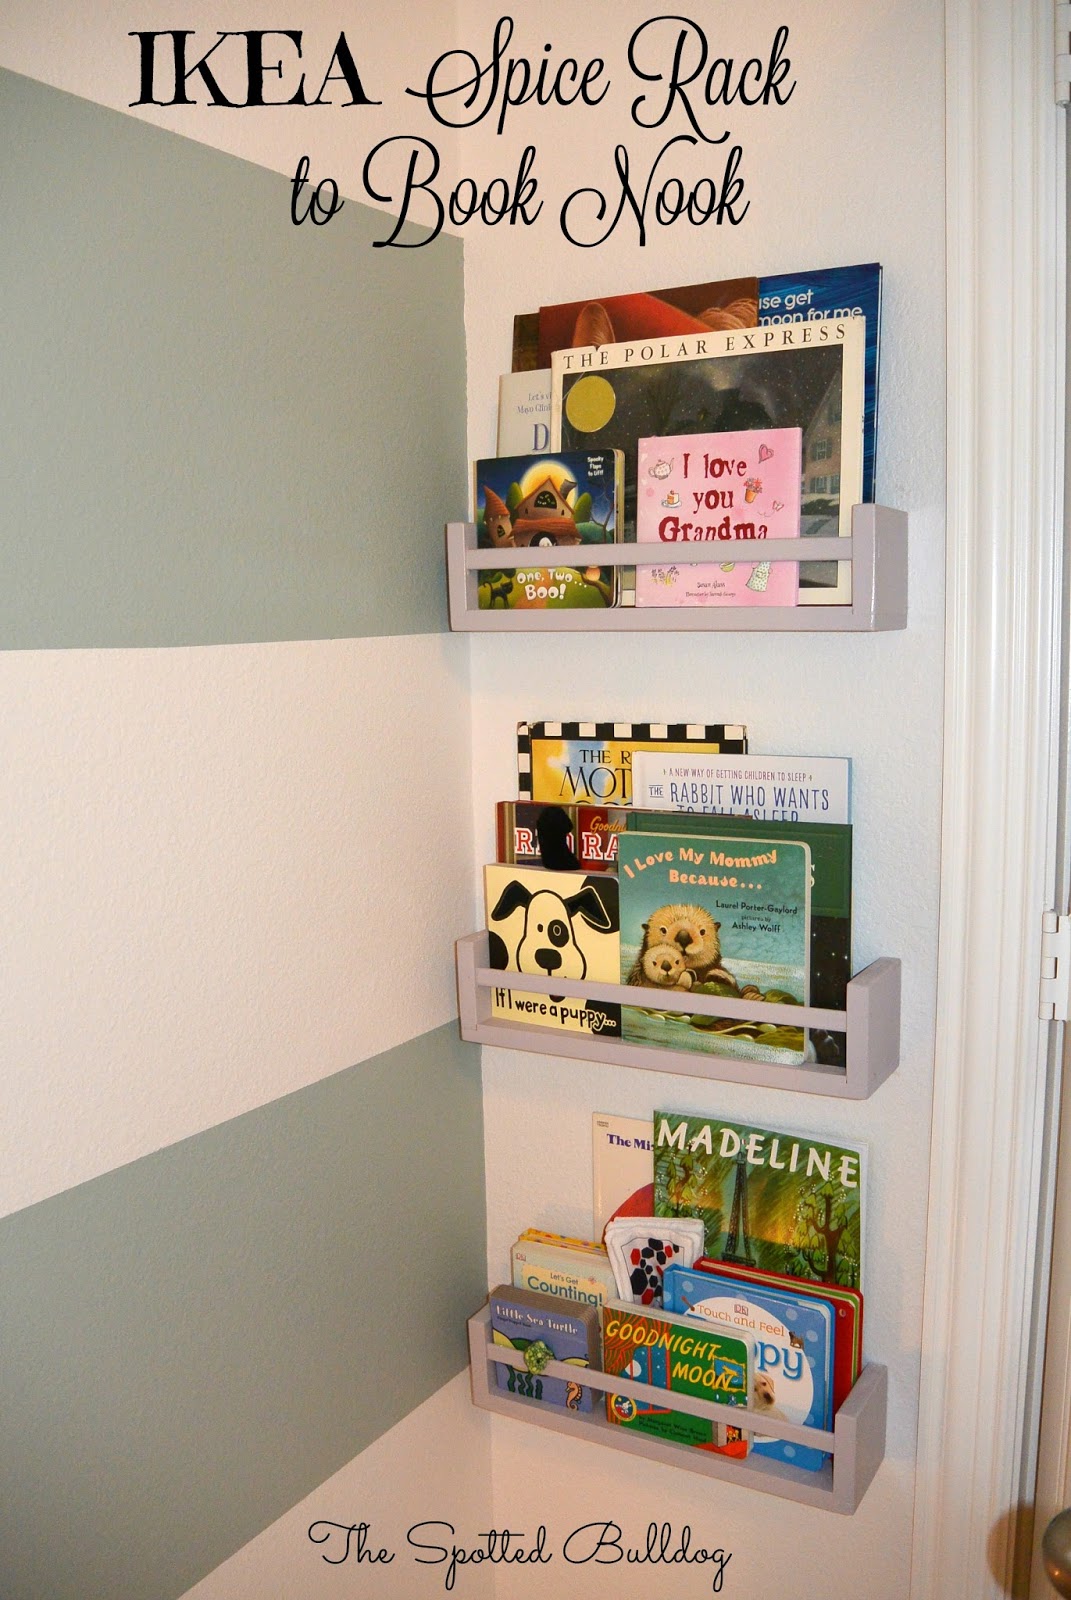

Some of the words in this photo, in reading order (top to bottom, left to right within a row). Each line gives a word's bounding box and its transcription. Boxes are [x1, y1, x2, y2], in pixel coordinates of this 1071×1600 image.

[784, 289, 814, 310] get
[807, 308, 832, 321] for
[833, 306, 863, 318] me
[563, 351, 609, 369] THE
[625, 340, 708, 363] POLAR
[724, 323, 847, 351] EXPRESS
[532, 422, 550, 451] D
[682, 453, 691, 479] I
[703, 453, 747, 479] love
[693, 489, 734, 514] you
[658, 516, 768, 543] Grandma
[516, 570, 545, 584] One,
[524, 583, 567, 601] Boo!
[578, 749, 612, 764] THE
[558, 765, 632, 799] MOT
[669, 768, 674, 776] A
[675, 768, 690, 778] NEW
[690, 768, 704, 778] WAY
[706, 769, 714, 778] OF
[716, 769, 743, 780] GETTING
[744, 770, 775, 781] CHILDREN
[777, 771, 786, 782] TO
[787, 772, 807, 782] SLEEP
[649, 786, 663, 796] THE
[670, 782, 724, 805] RABBIT
[730, 784, 766, 806] WHO
[773, 786, 829, 811] WANTS
[623, 864, 635, 878] I
[634, 850, 674, 871] Love
[679, 848, 704, 864] My
[709, 850, 777, 868] Mommy
[669, 869, 763, 890] Because...
[715, 900, 739, 911] Laurel
[740, 901, 798, 915] Porter-Gaylord
[741, 915, 763, 923] pictures
[731, 921, 757, 932] Ashley
[759, 922, 781, 933] Wolff
[495, 987, 506, 1008] If
[507, 989, 512, 1009] I
[515, 999, 547, 1015] were
[549, 1005, 558, 1017] a
[560, 1007, 616, 1031] puppy...
[606, 1133, 631, 1148] The
[657, 1119, 859, 1188] MADELINE
[527, 1275, 603, 1307] Counting!
[550, 1272, 564, 1282] Let's
[565, 1276, 578, 1285] Get
[496, 1305, 524, 1321] Little
[526, 1313, 544, 1326] Sea
[546, 1318, 578, 1334] Turtle
[697, 1304, 731, 1322] Touch
[733, 1316, 756, 1330] and
[759, 1323, 785, 1337] Feel
[734, 1304, 748, 1316] DK
[606, 1320, 721, 1361] GOODNIGHT
[672, 1361, 735, 1390] MOON
